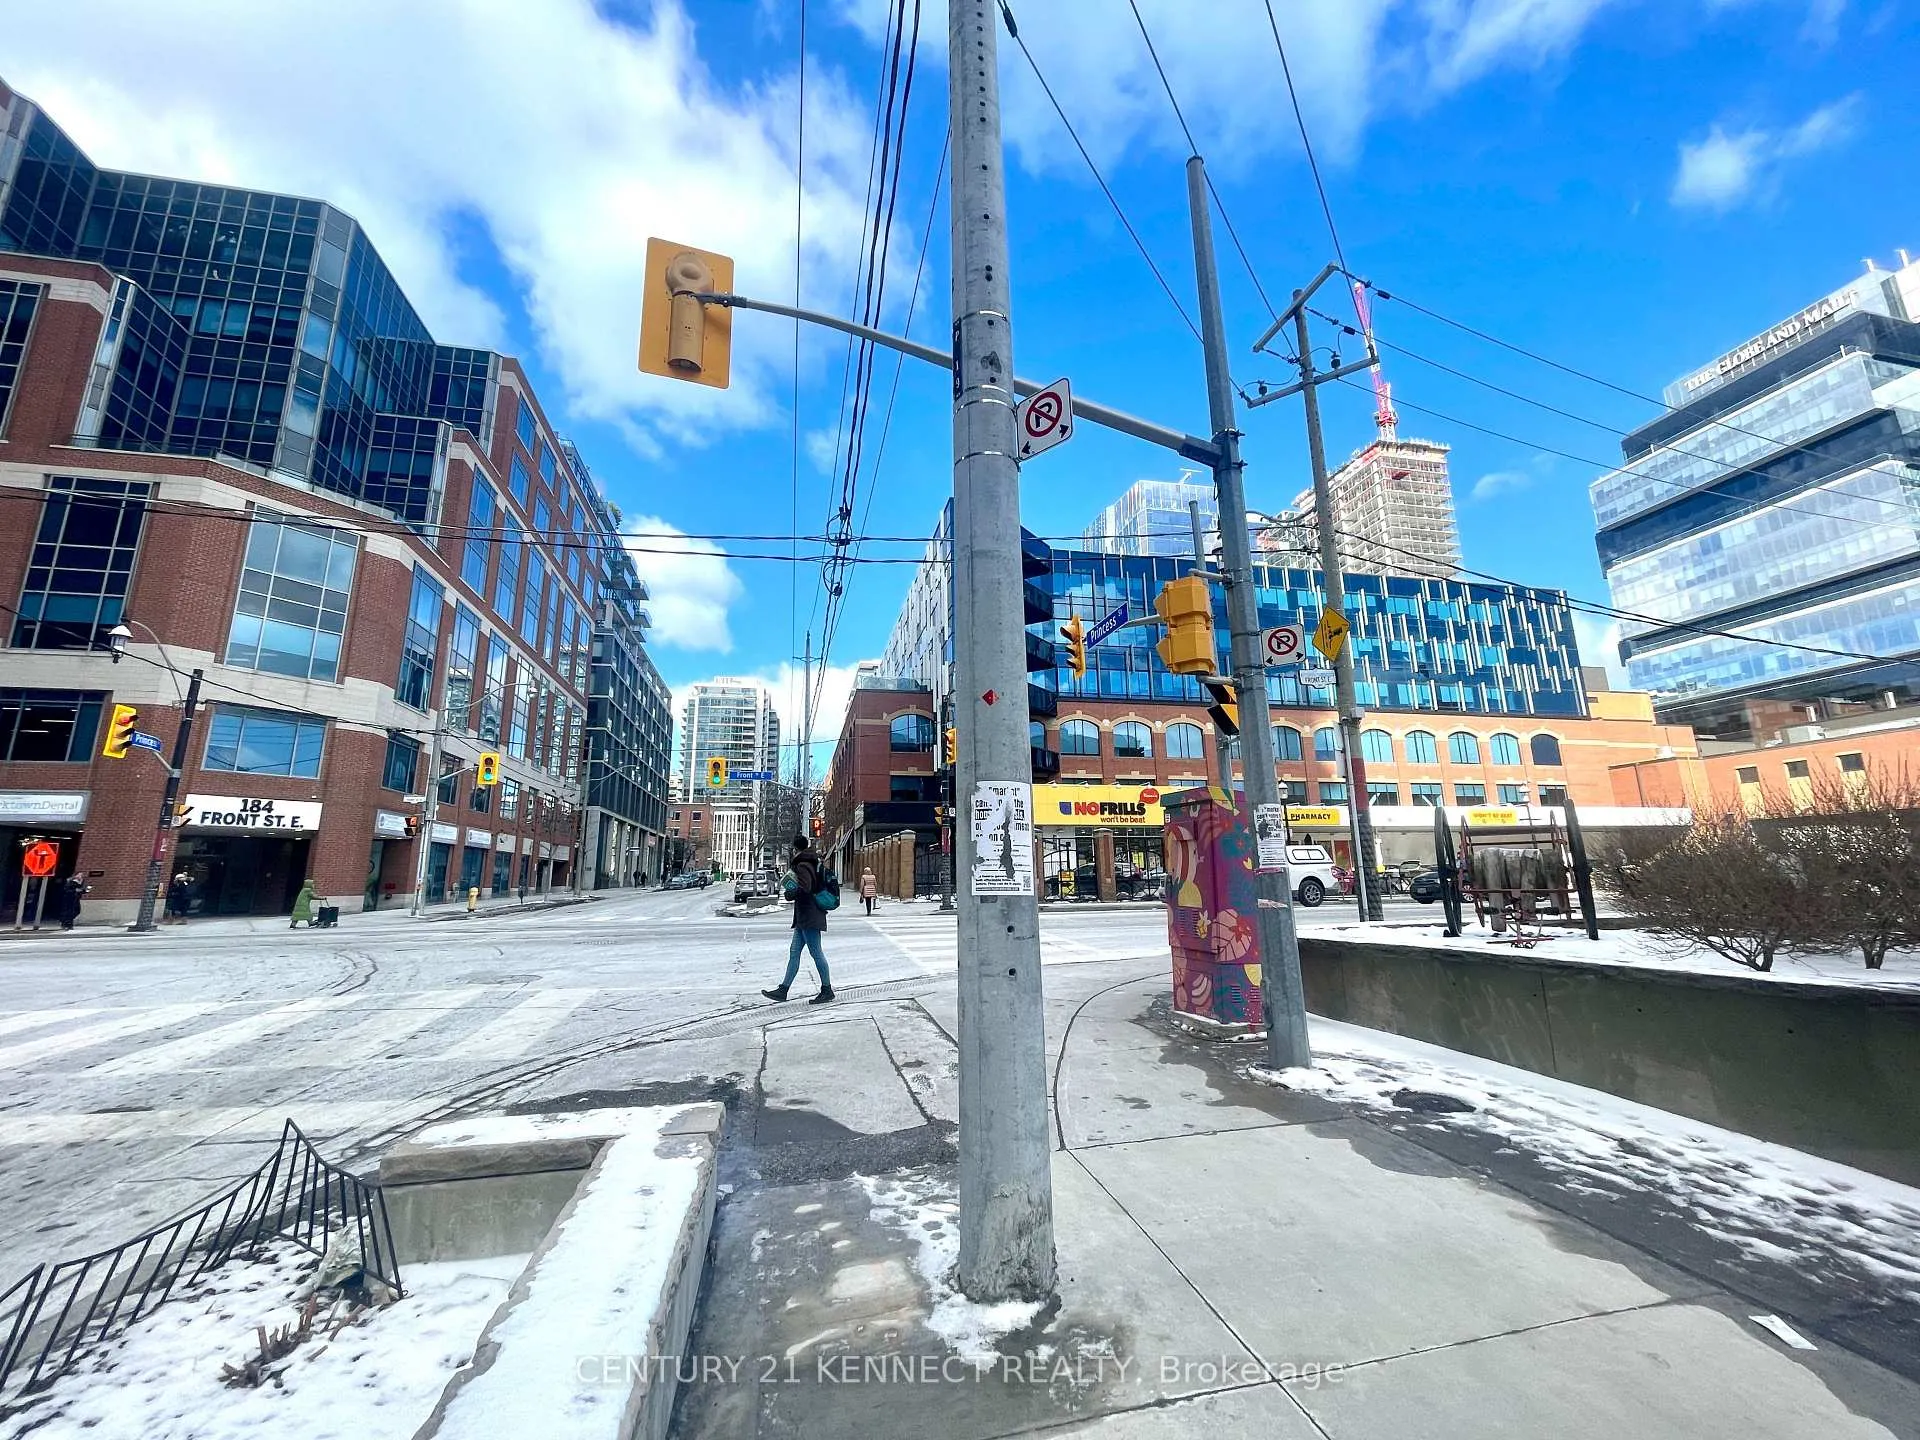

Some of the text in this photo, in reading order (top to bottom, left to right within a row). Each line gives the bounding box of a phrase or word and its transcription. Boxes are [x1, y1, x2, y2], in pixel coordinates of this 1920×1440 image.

[1684, 367, 1715, 392] THE
[1716, 340, 1766, 375] GLOBE
[1766, 320, 1801, 346] AND
[1090, 616, 1117, 643] Princess
[239, 798, 274, 814] 184
[200, 811, 304, 829] FRONT ST. E.
